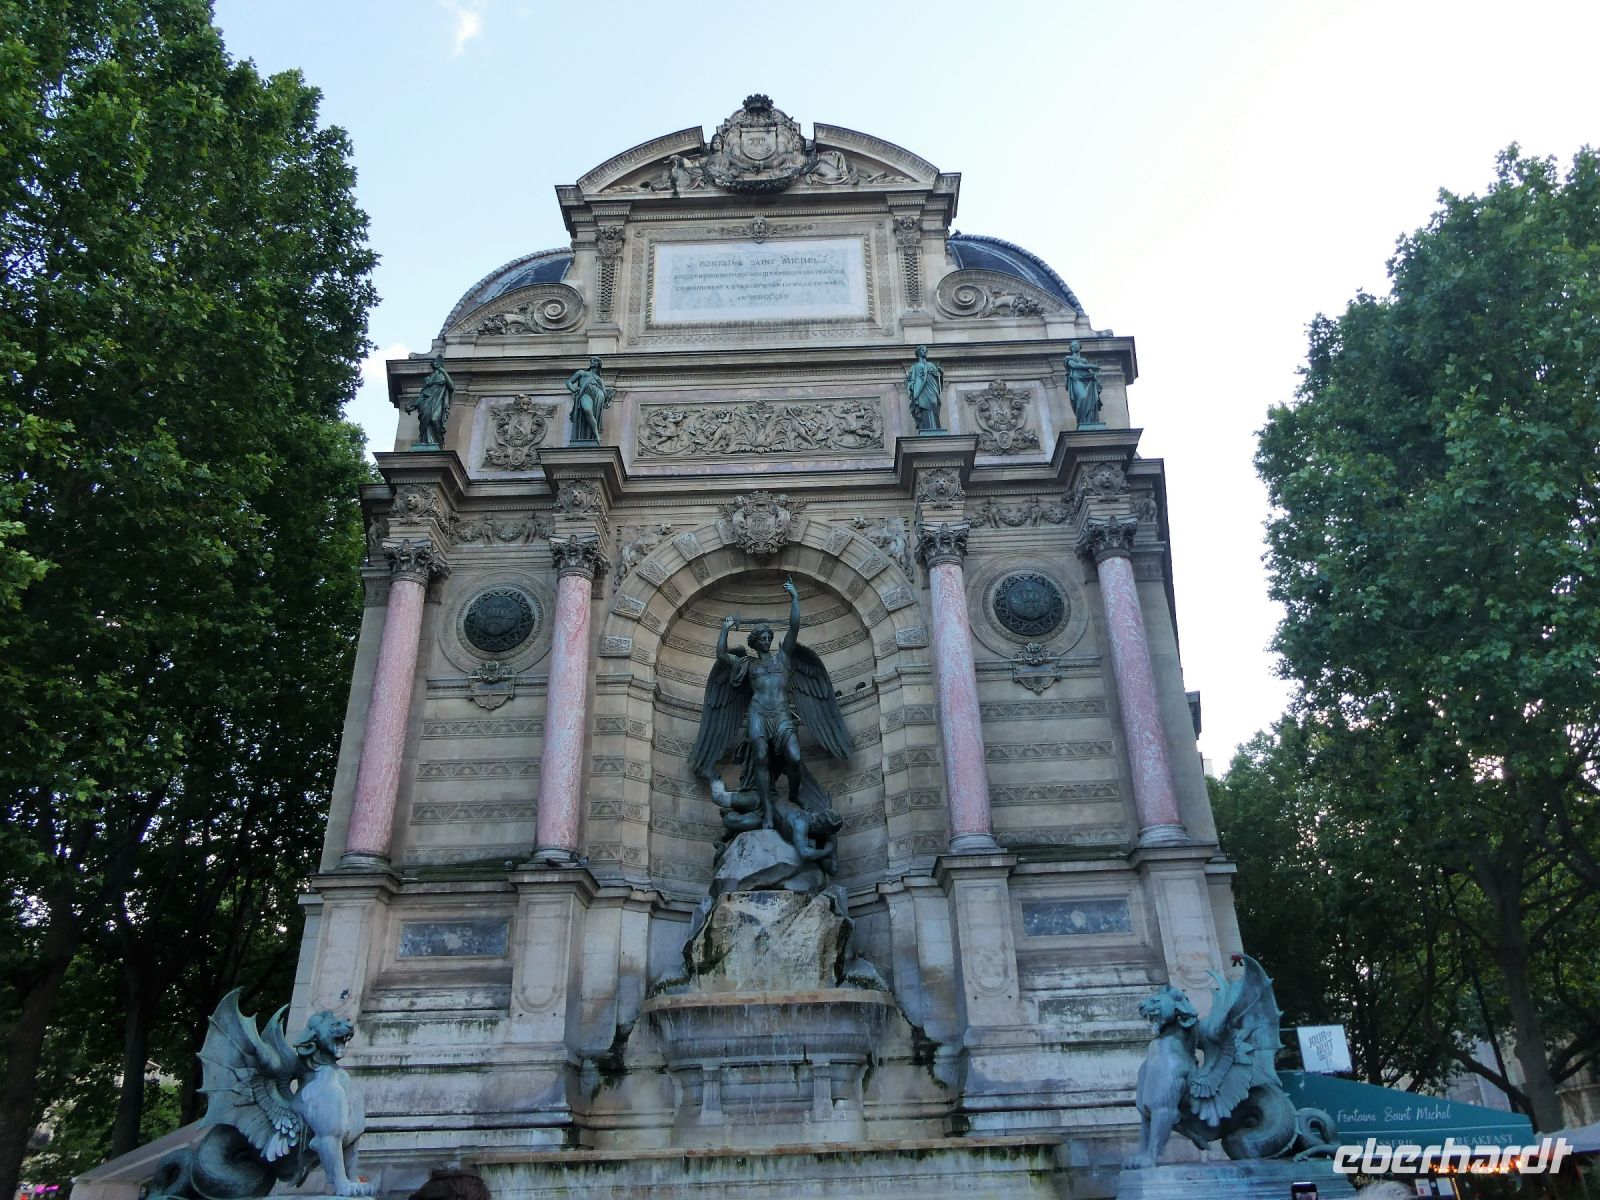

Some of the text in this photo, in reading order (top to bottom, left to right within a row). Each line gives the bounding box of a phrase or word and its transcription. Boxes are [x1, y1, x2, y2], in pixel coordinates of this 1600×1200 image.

[699, 257, 819, 267] FONTAINE SAINT MICHEL
[1308, 1031, 1327, 1048] JOUR
[1316, 1038, 1334, 1055] NUIT
[1336, 1103, 1450, 1122] Fontaine Saint Michel
[1453, 1134, 1513, 1146] REAKFAST
